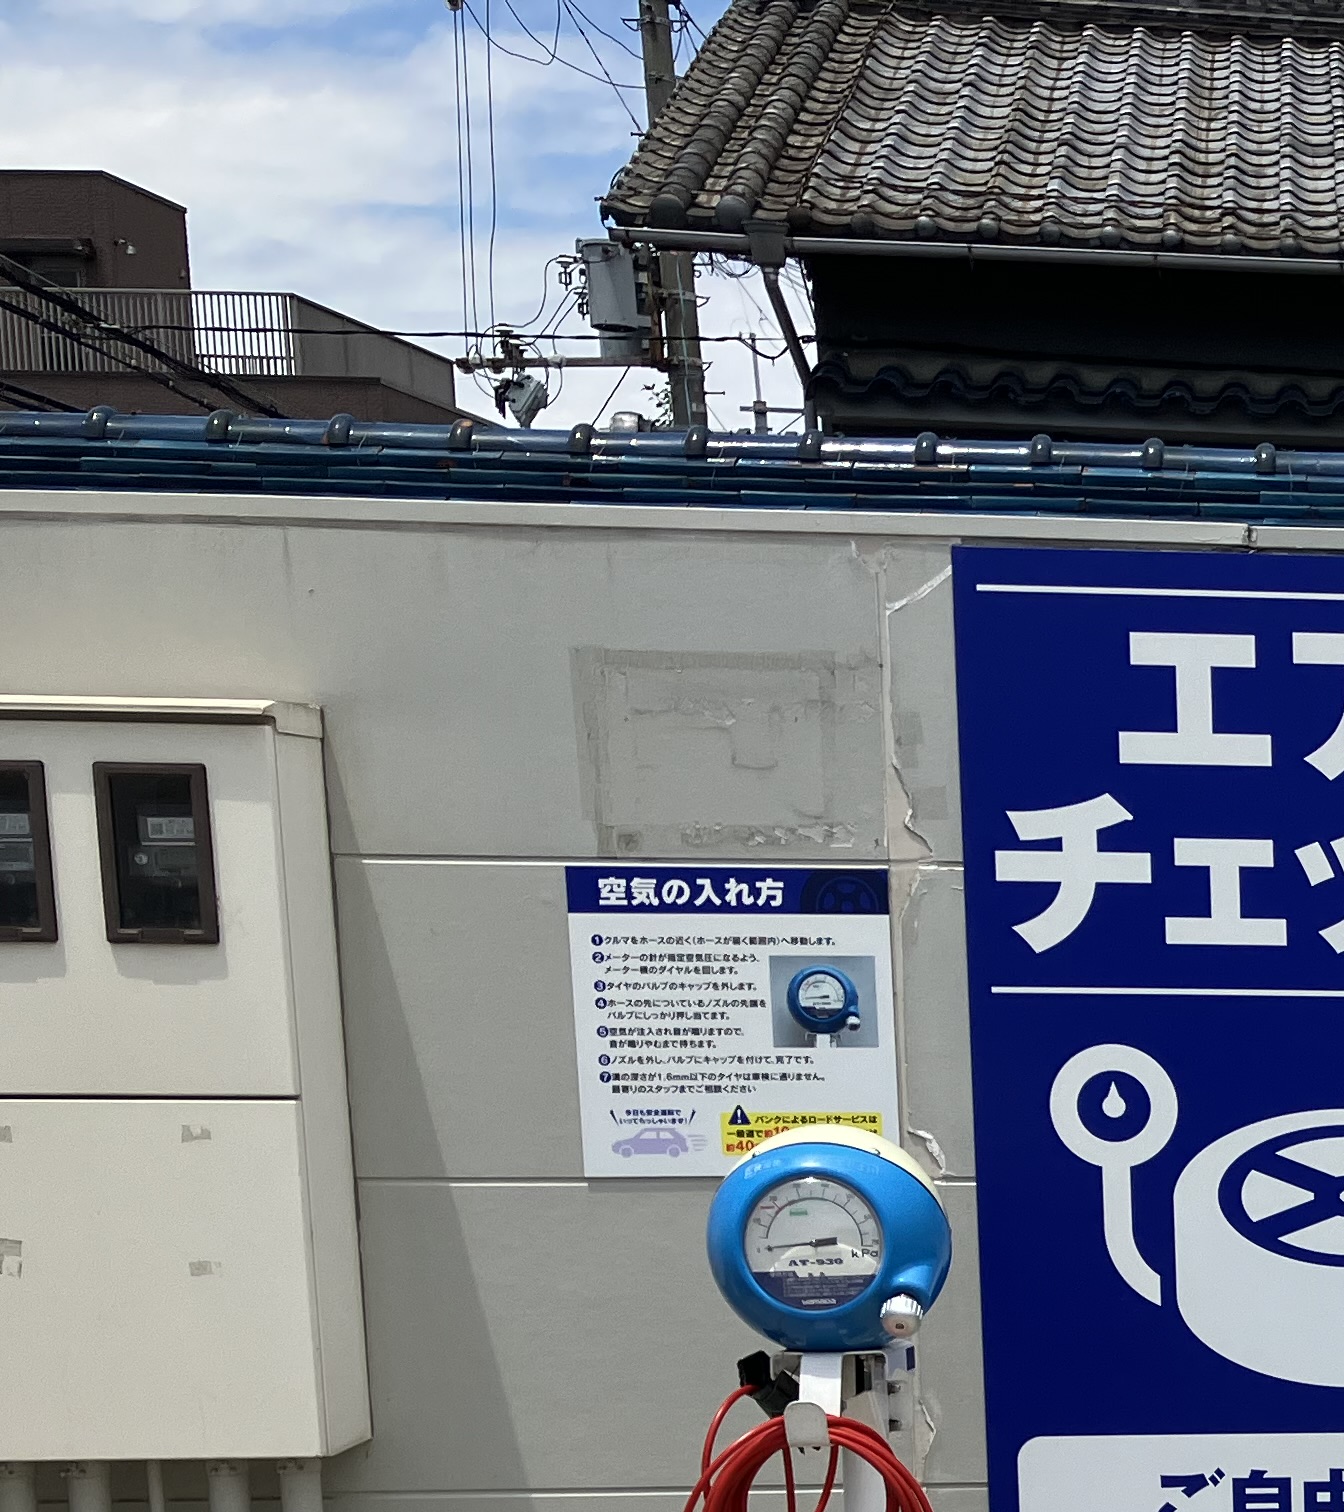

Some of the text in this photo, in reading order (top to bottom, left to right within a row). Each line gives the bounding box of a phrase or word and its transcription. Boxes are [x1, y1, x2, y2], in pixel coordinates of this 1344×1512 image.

[597, 877, 785, 907] 空気の入れ方
